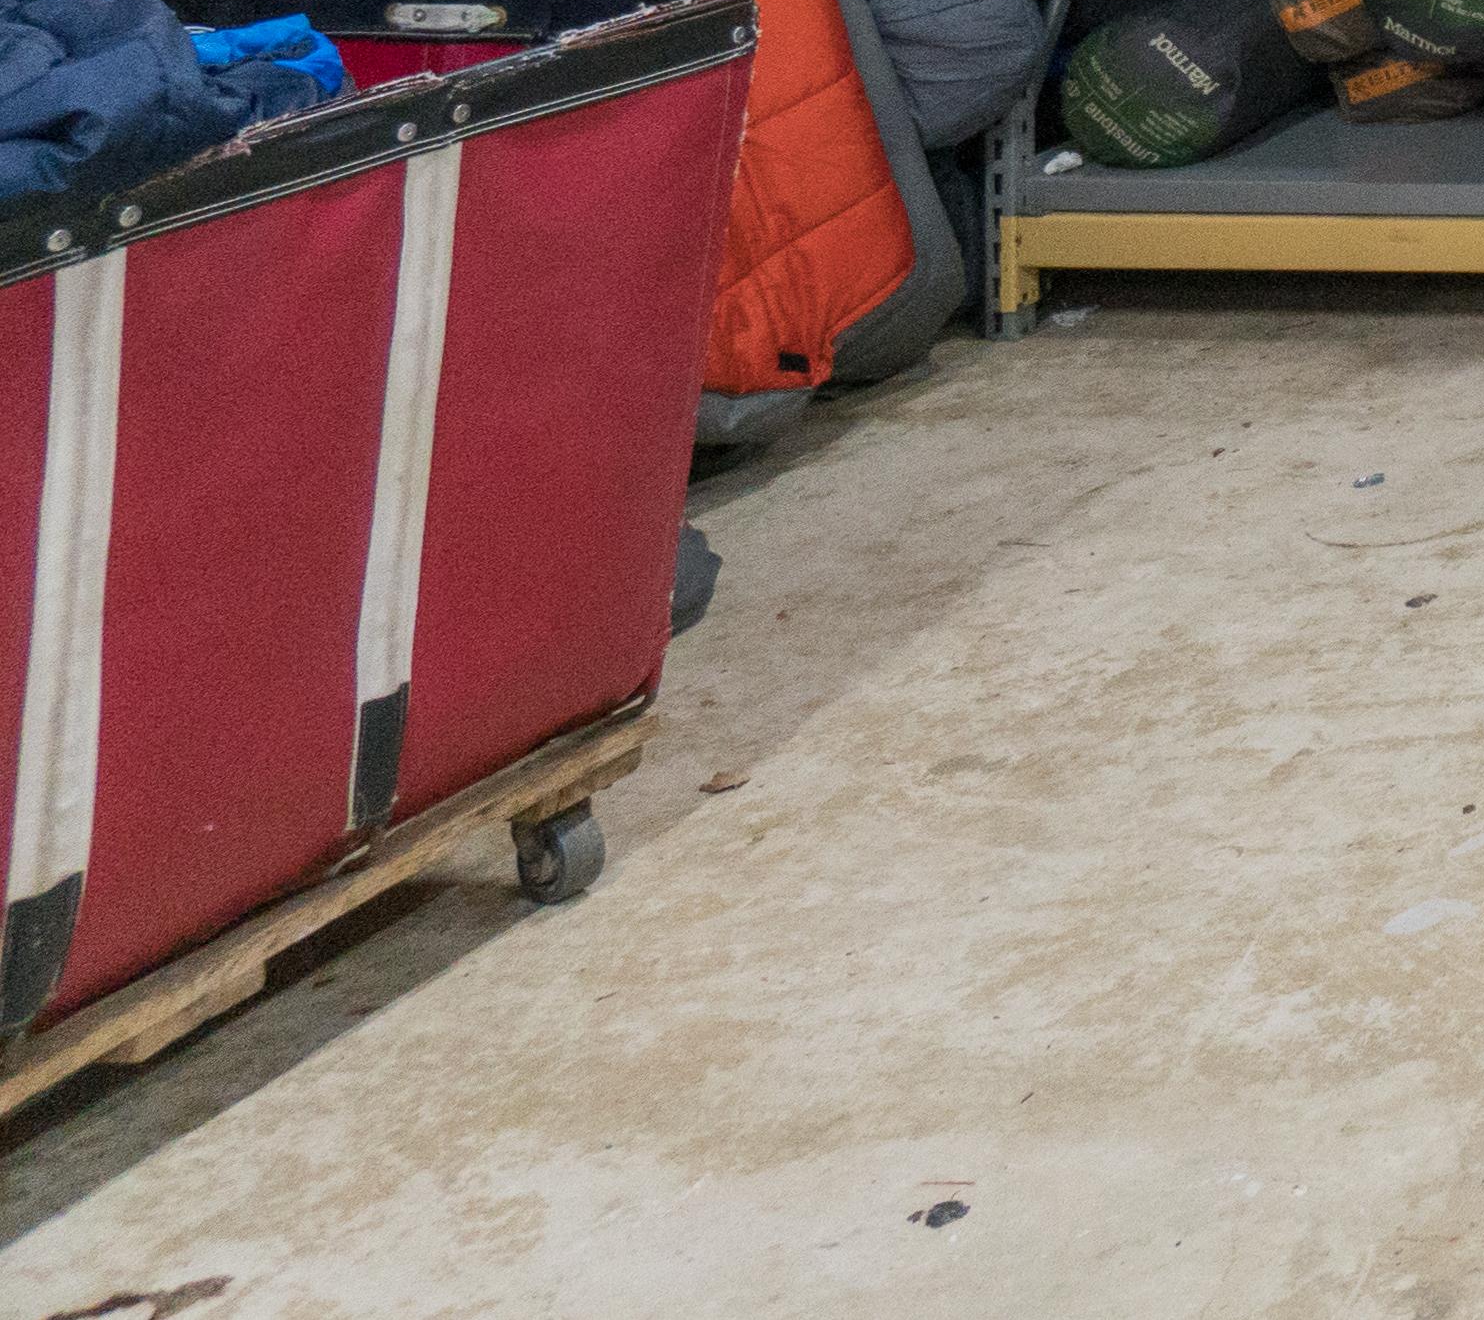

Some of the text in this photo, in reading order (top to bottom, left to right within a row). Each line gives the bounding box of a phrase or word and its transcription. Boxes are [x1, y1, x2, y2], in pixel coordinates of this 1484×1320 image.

[1150, 32, 1221, 96] Marmot
[1383, 15, 1457, 56] Marmot
[1085, 102, 1161, 162] Limestone
